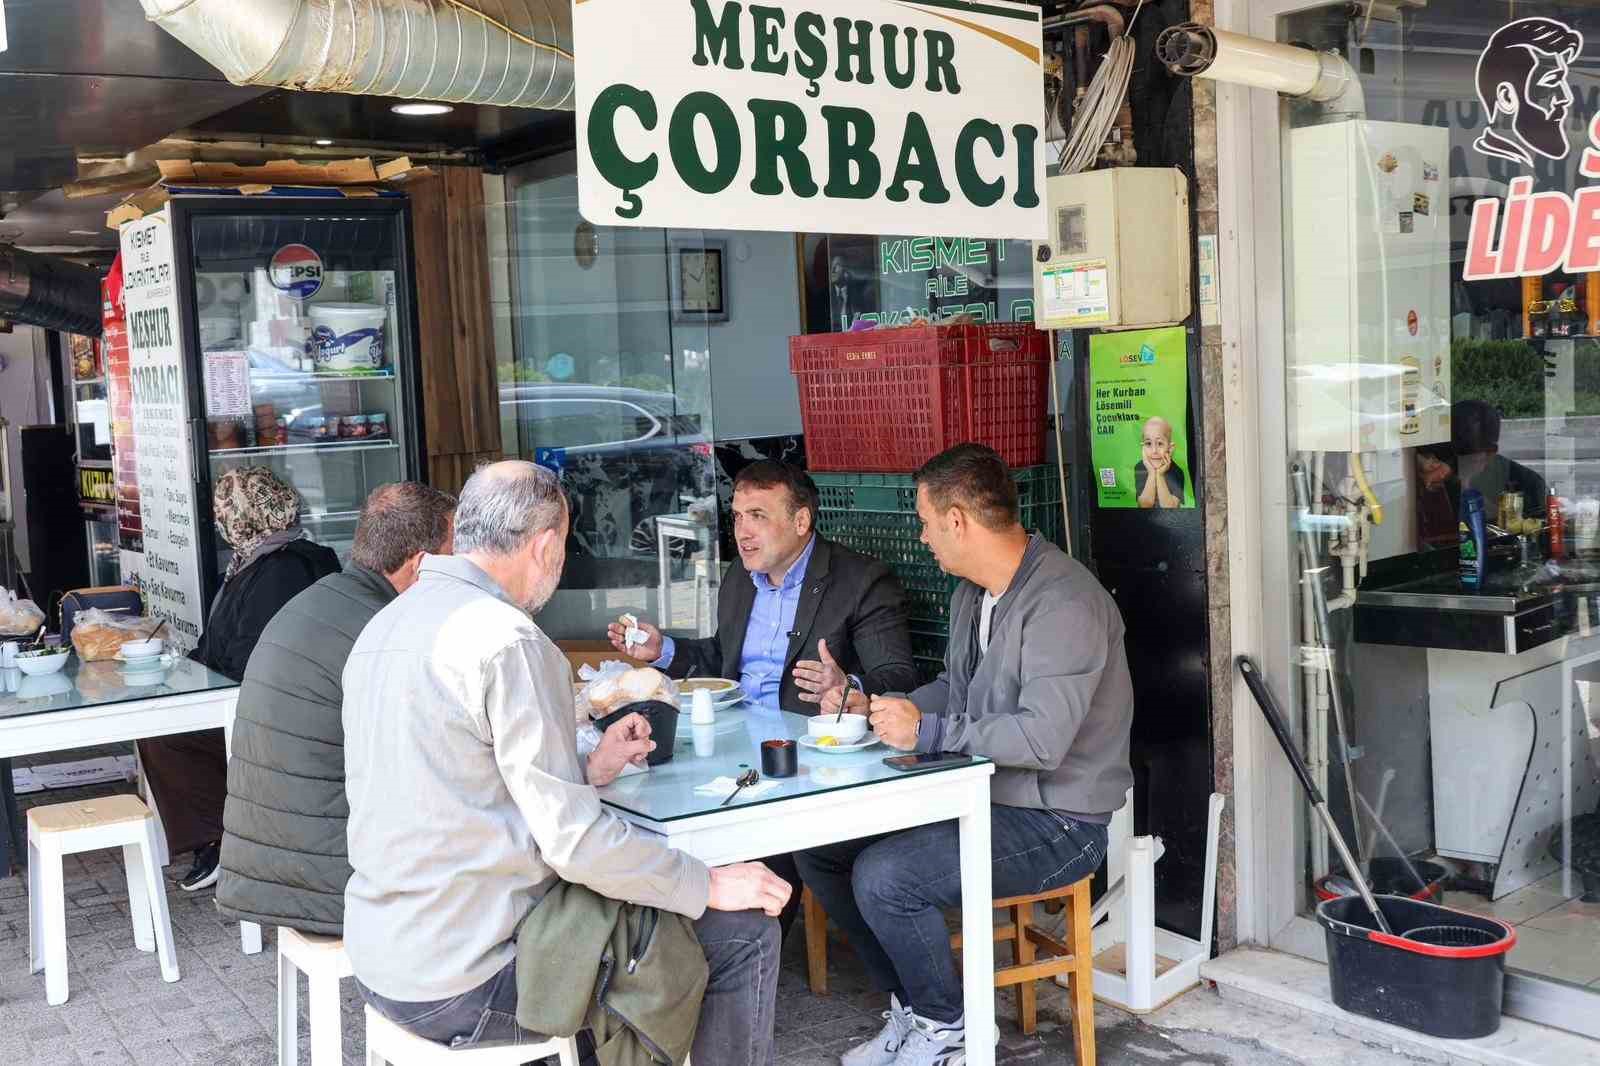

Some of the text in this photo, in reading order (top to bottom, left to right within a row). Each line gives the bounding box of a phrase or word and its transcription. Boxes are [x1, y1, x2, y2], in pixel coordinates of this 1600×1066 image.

[691, 0, 961, 97] MEŞHUR
[587, 83, 1040, 219] ÇORBACI
[273, 265, 321, 278] EPSI
[925, 273, 969, 299] AİLE
[130, 306, 173, 360] MEŞHUR
[1096, 387, 1146, 398] Her Kurban
[1097, 425, 1114, 435] CAN
[161, 582, 186, 606] Kavurma
[172, 612, 199, 639] Kavurma
